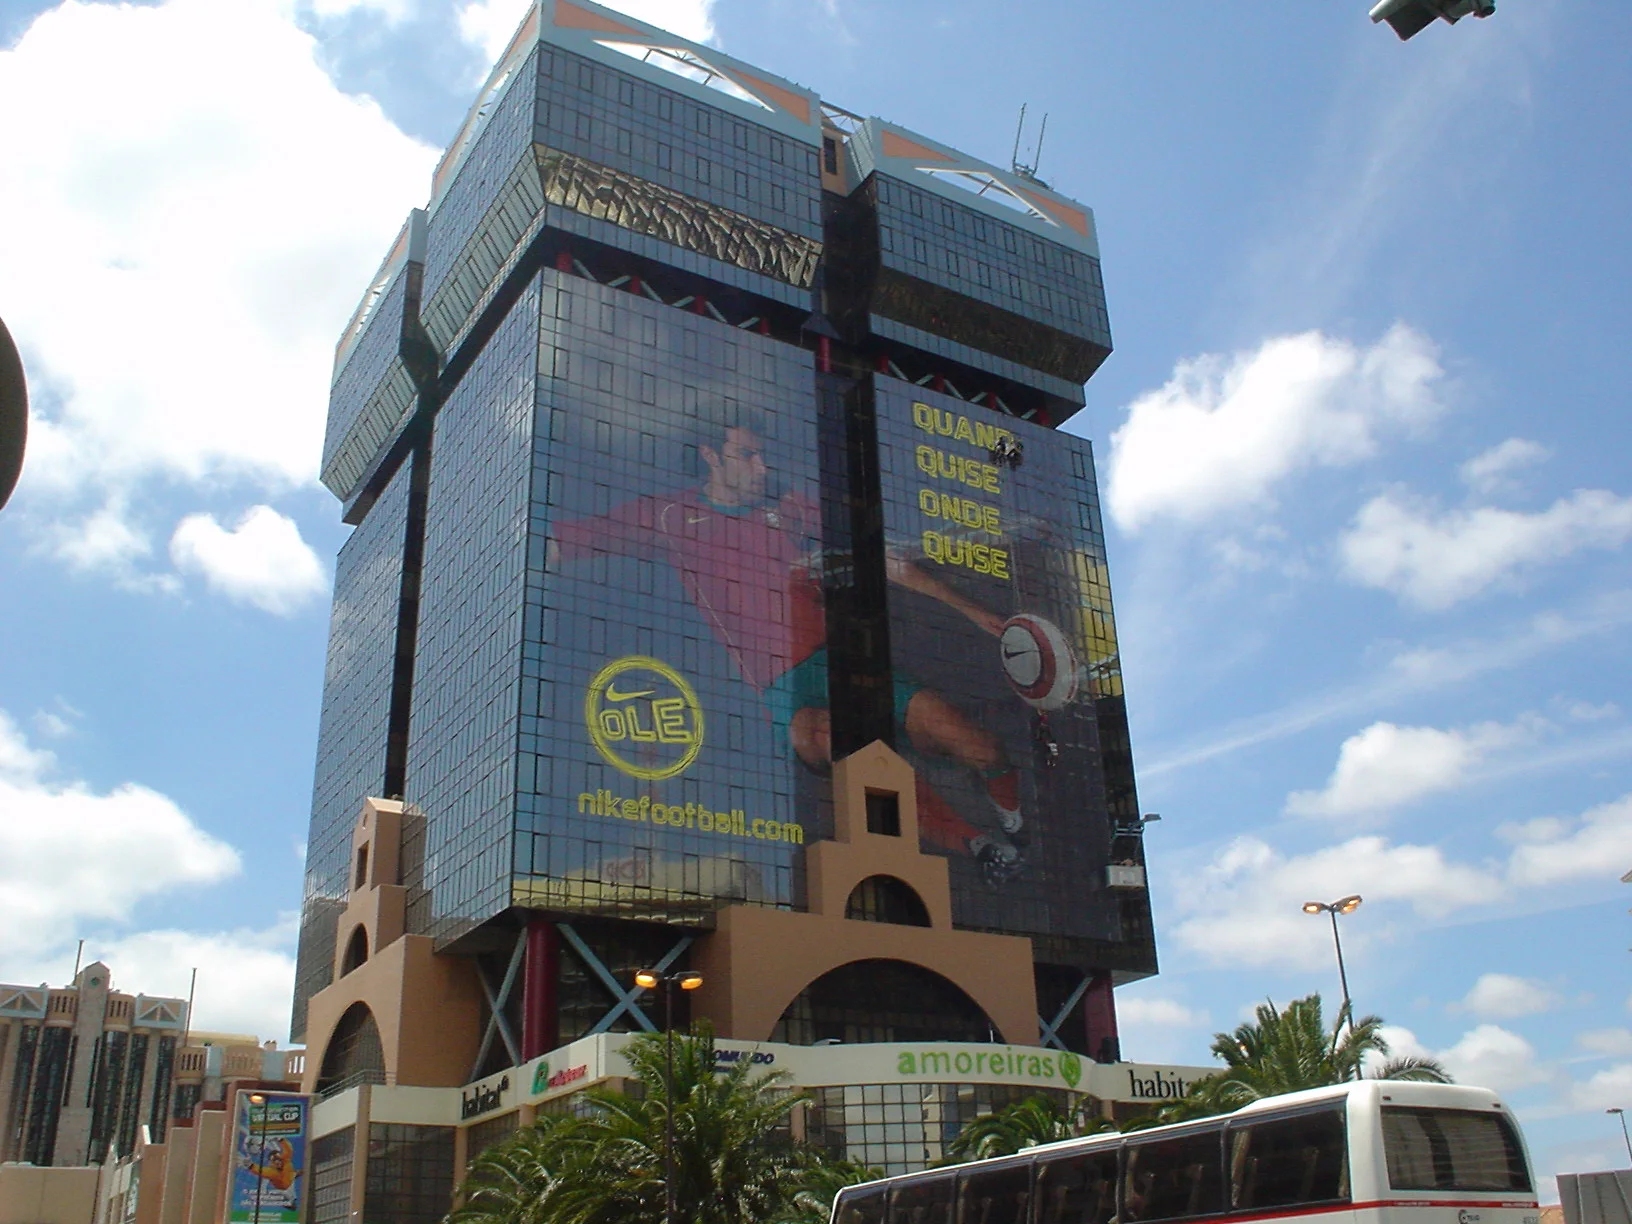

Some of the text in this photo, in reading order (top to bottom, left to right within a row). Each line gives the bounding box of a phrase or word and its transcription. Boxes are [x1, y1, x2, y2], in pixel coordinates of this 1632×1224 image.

[916, 445, 1000, 494] QUISE
[919, 488, 1002, 535] ONDE
[922, 530, 1010, 580] QUISE
[600, 698, 694, 743] OLE
[577, 788, 804, 844] nikefootball.com
[897, 1047, 1055, 1079] amoreiras
[1128, 1069, 1202, 1099] habit
